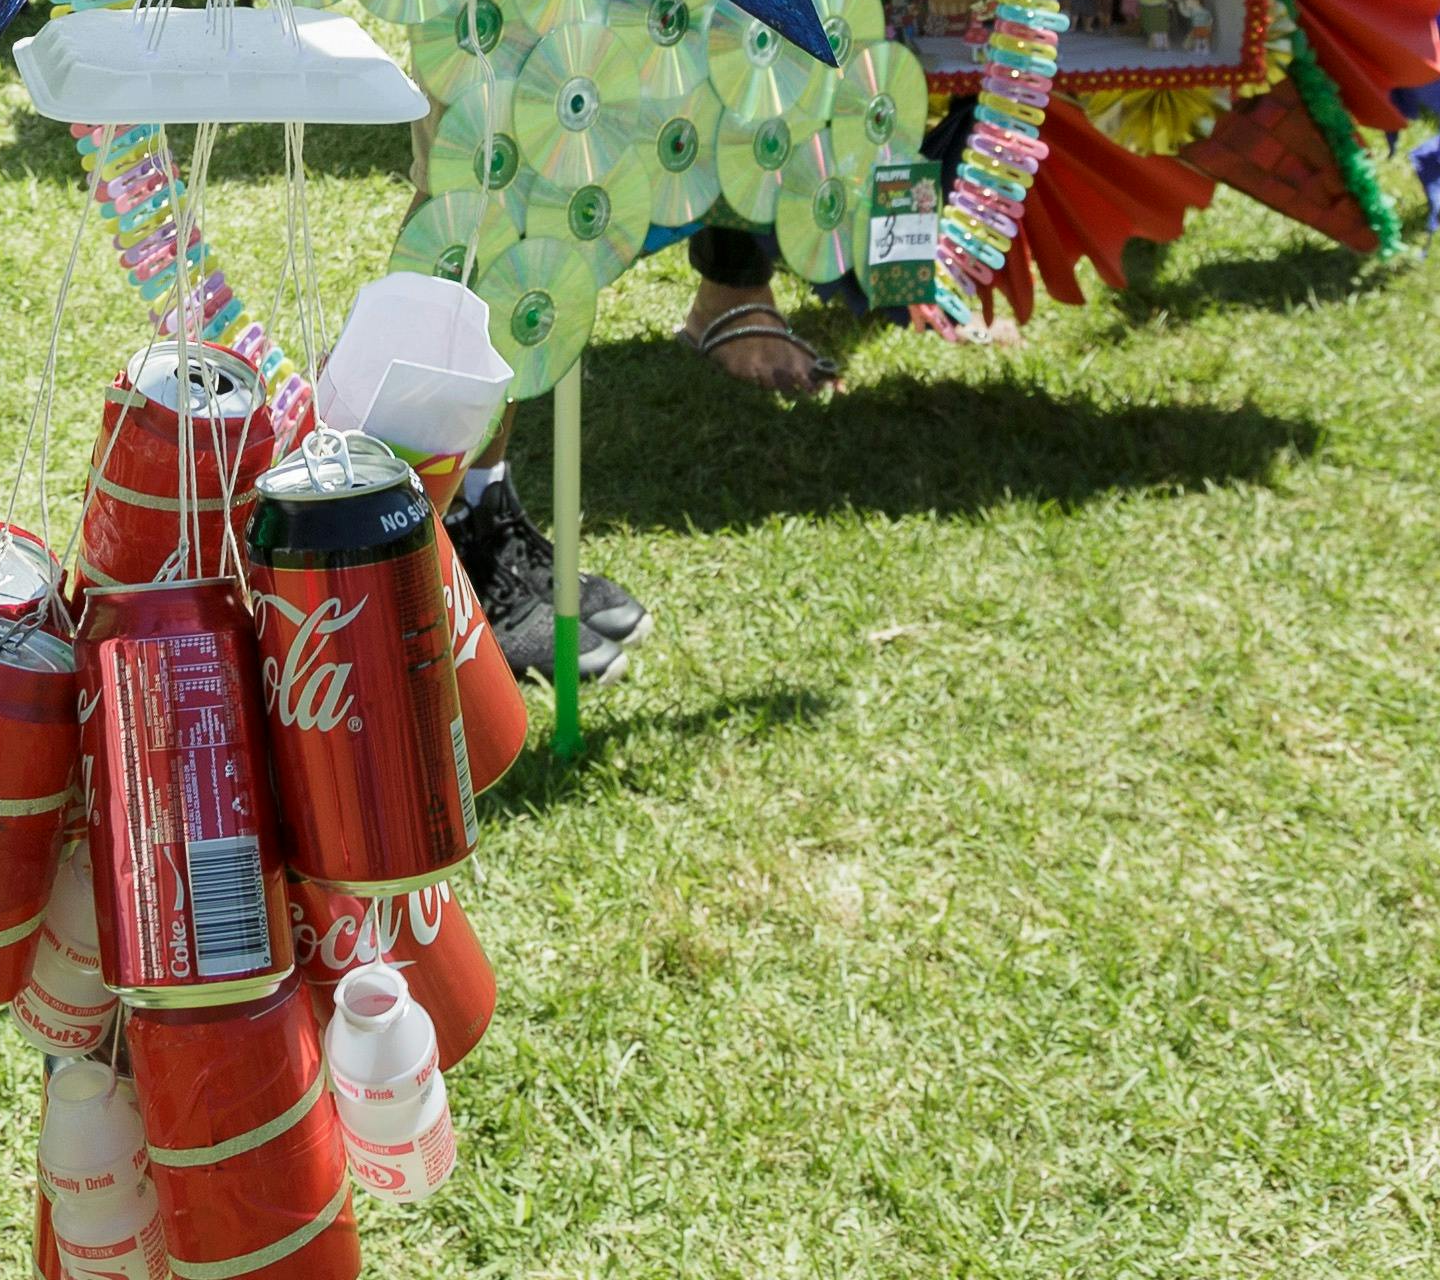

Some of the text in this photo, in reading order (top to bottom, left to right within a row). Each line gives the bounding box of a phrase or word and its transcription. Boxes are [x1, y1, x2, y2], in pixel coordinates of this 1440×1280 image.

[380, 510, 409, 533] NO
[171, 921, 189, 978] Coke
[15, 995, 85, 1044] Yakult
[85, 1172, 116, 1191] Drink
